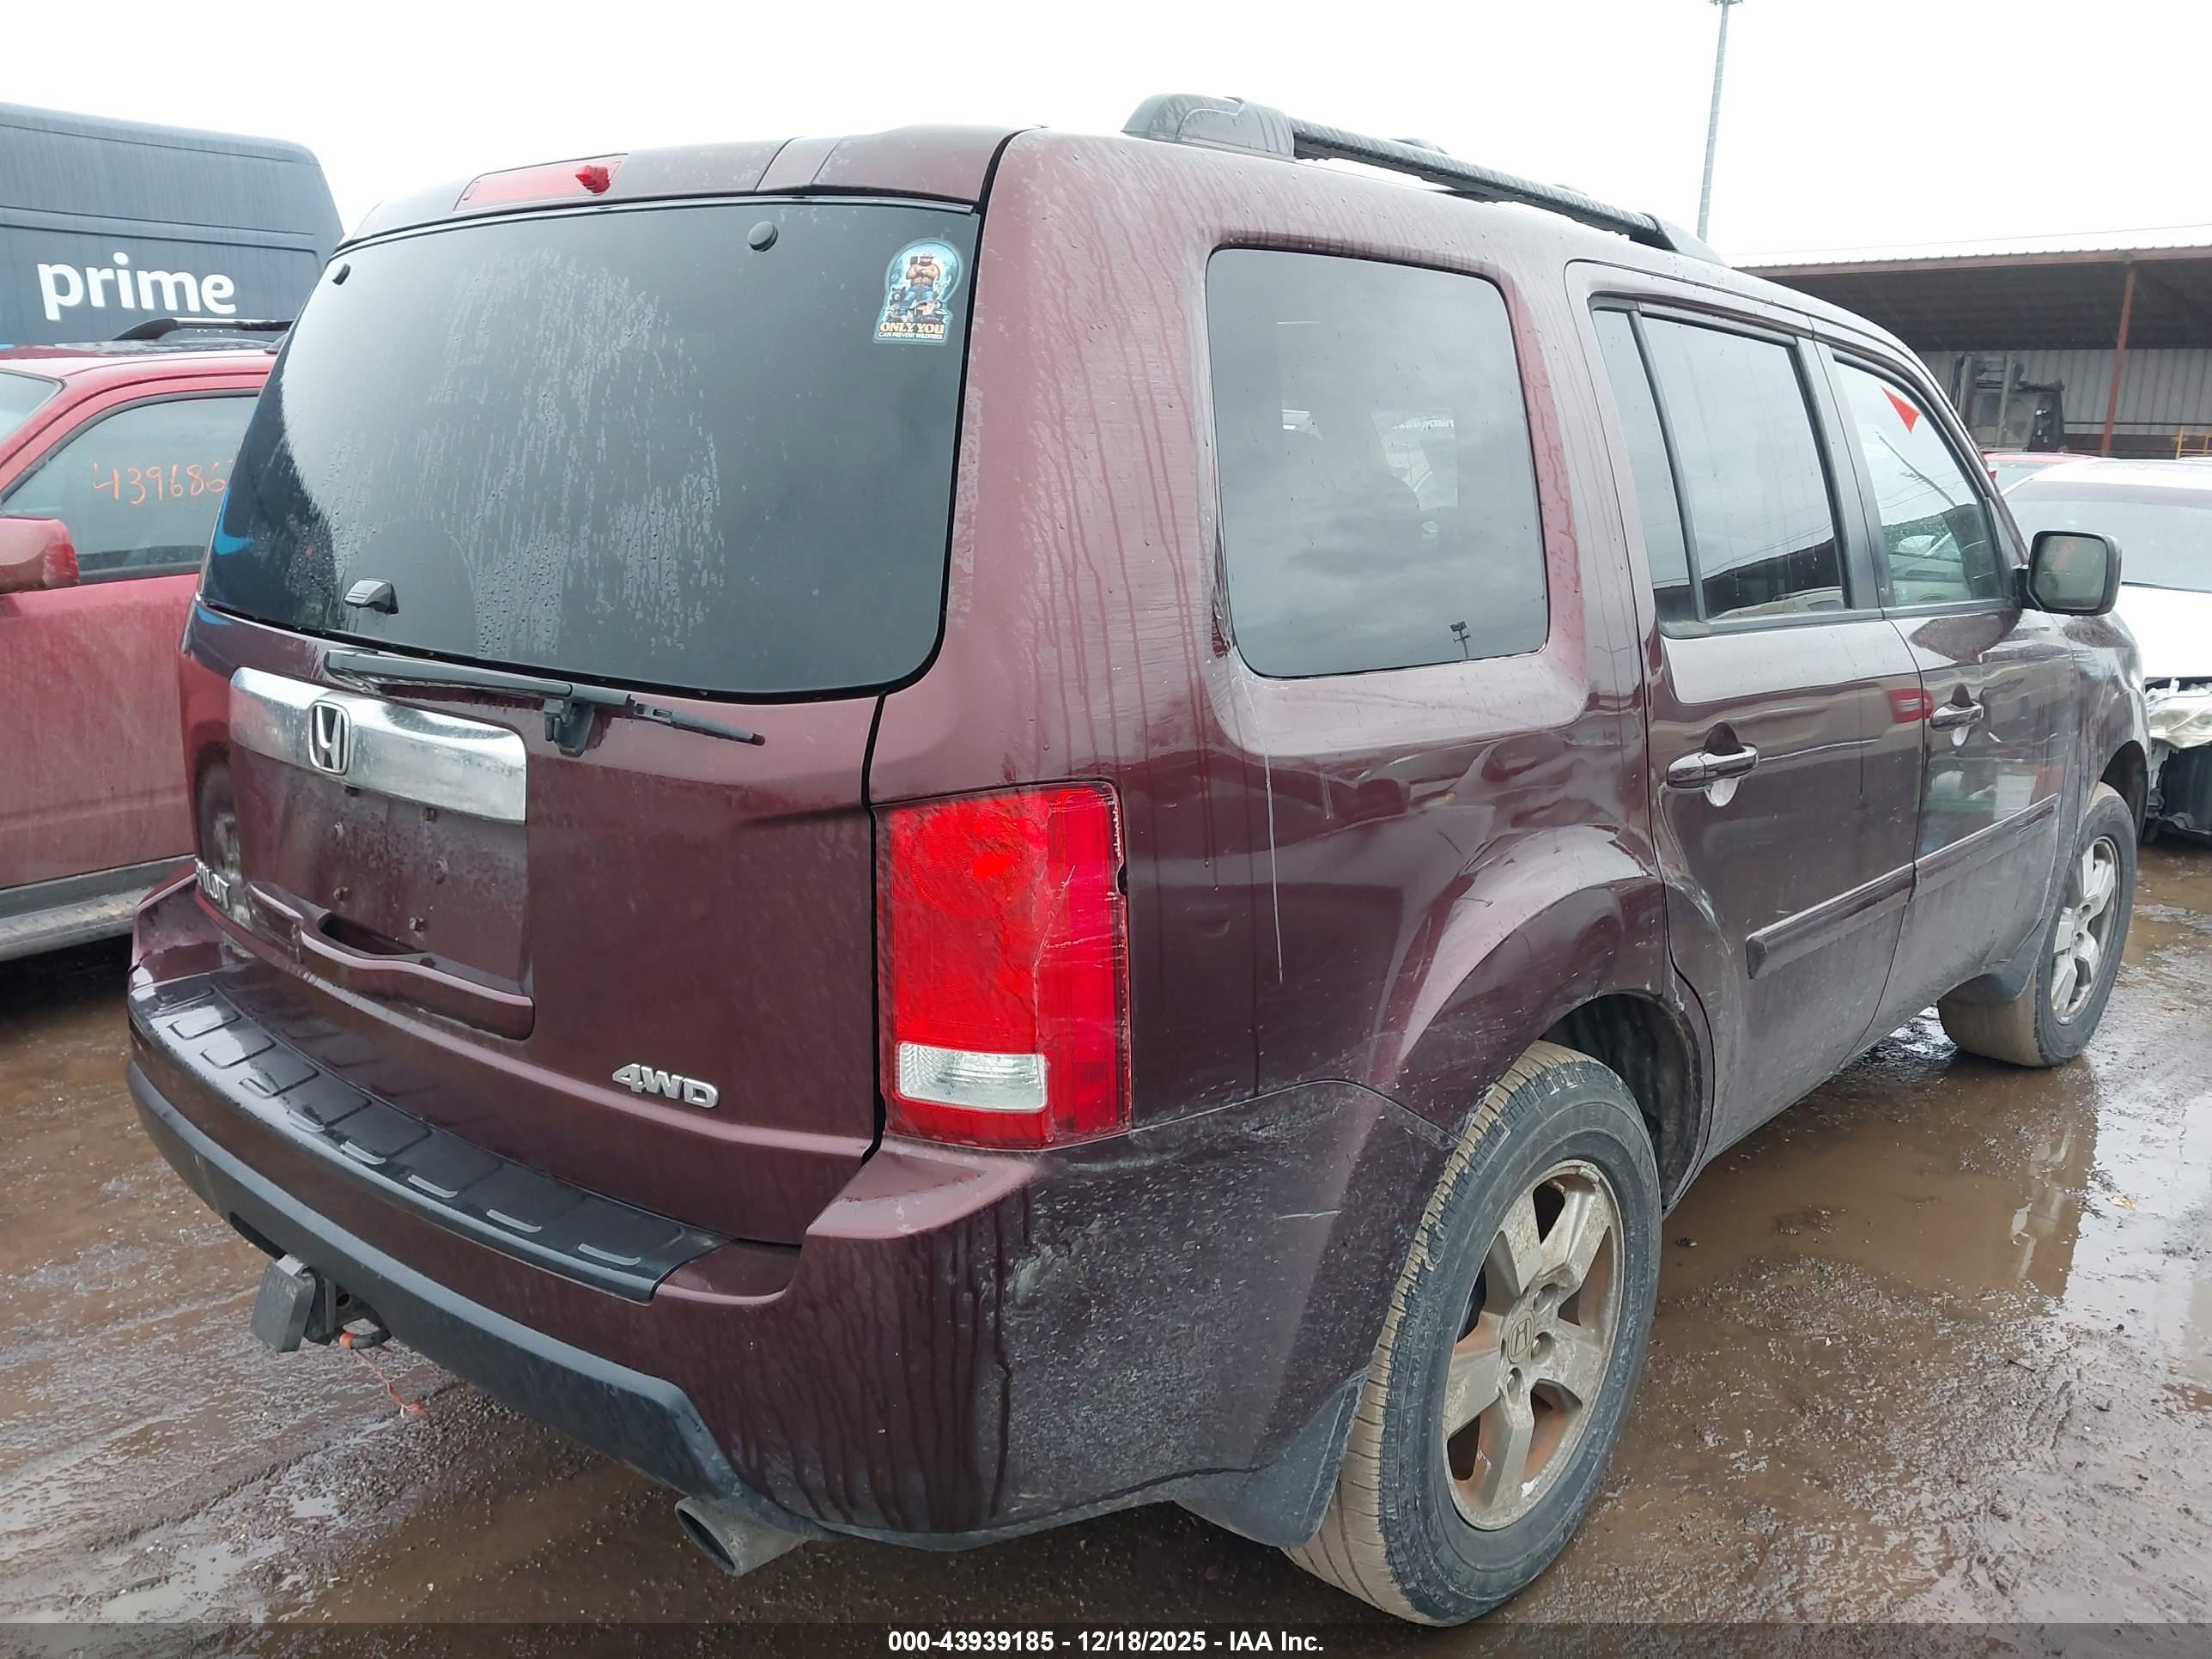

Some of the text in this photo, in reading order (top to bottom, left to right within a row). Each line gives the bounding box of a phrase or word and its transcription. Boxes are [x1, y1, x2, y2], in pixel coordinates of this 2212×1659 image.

[37, 252, 237, 321] prime
[879, 322, 945, 334] ONLY YOU
[93, 459, 234, 505] 439686
[611, 1063, 720, 1109] 4WD
